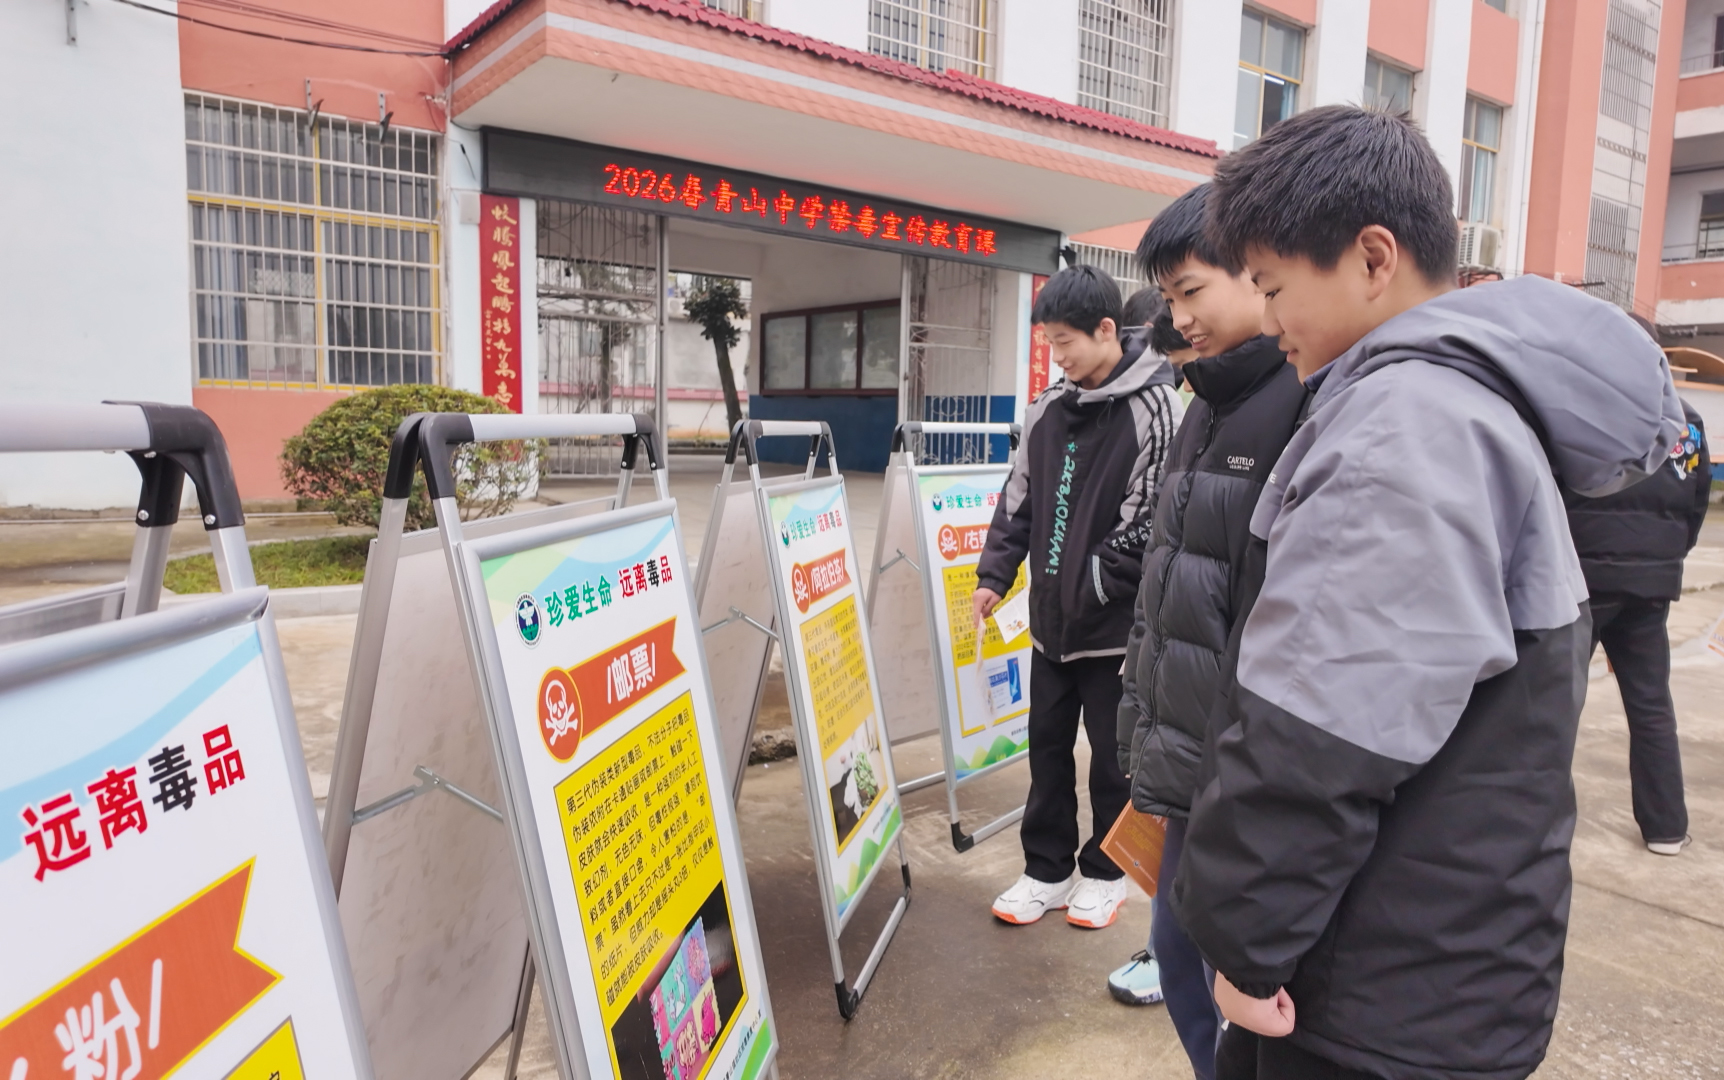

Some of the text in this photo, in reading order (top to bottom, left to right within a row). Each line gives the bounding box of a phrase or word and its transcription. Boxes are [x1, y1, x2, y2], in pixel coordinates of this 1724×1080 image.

[603, 163, 998, 256] 2026春青山中学禁毒宣传教育课
[1227, 455, 1255, 467] CARTELO
[790, 510, 842, 541] 珍爱生命 远离毒品
[544, 575, 613, 628] 珍爱生命
[618, 555, 673, 598] 远离毒品
[22, 724, 246, 882] 远离毒品
